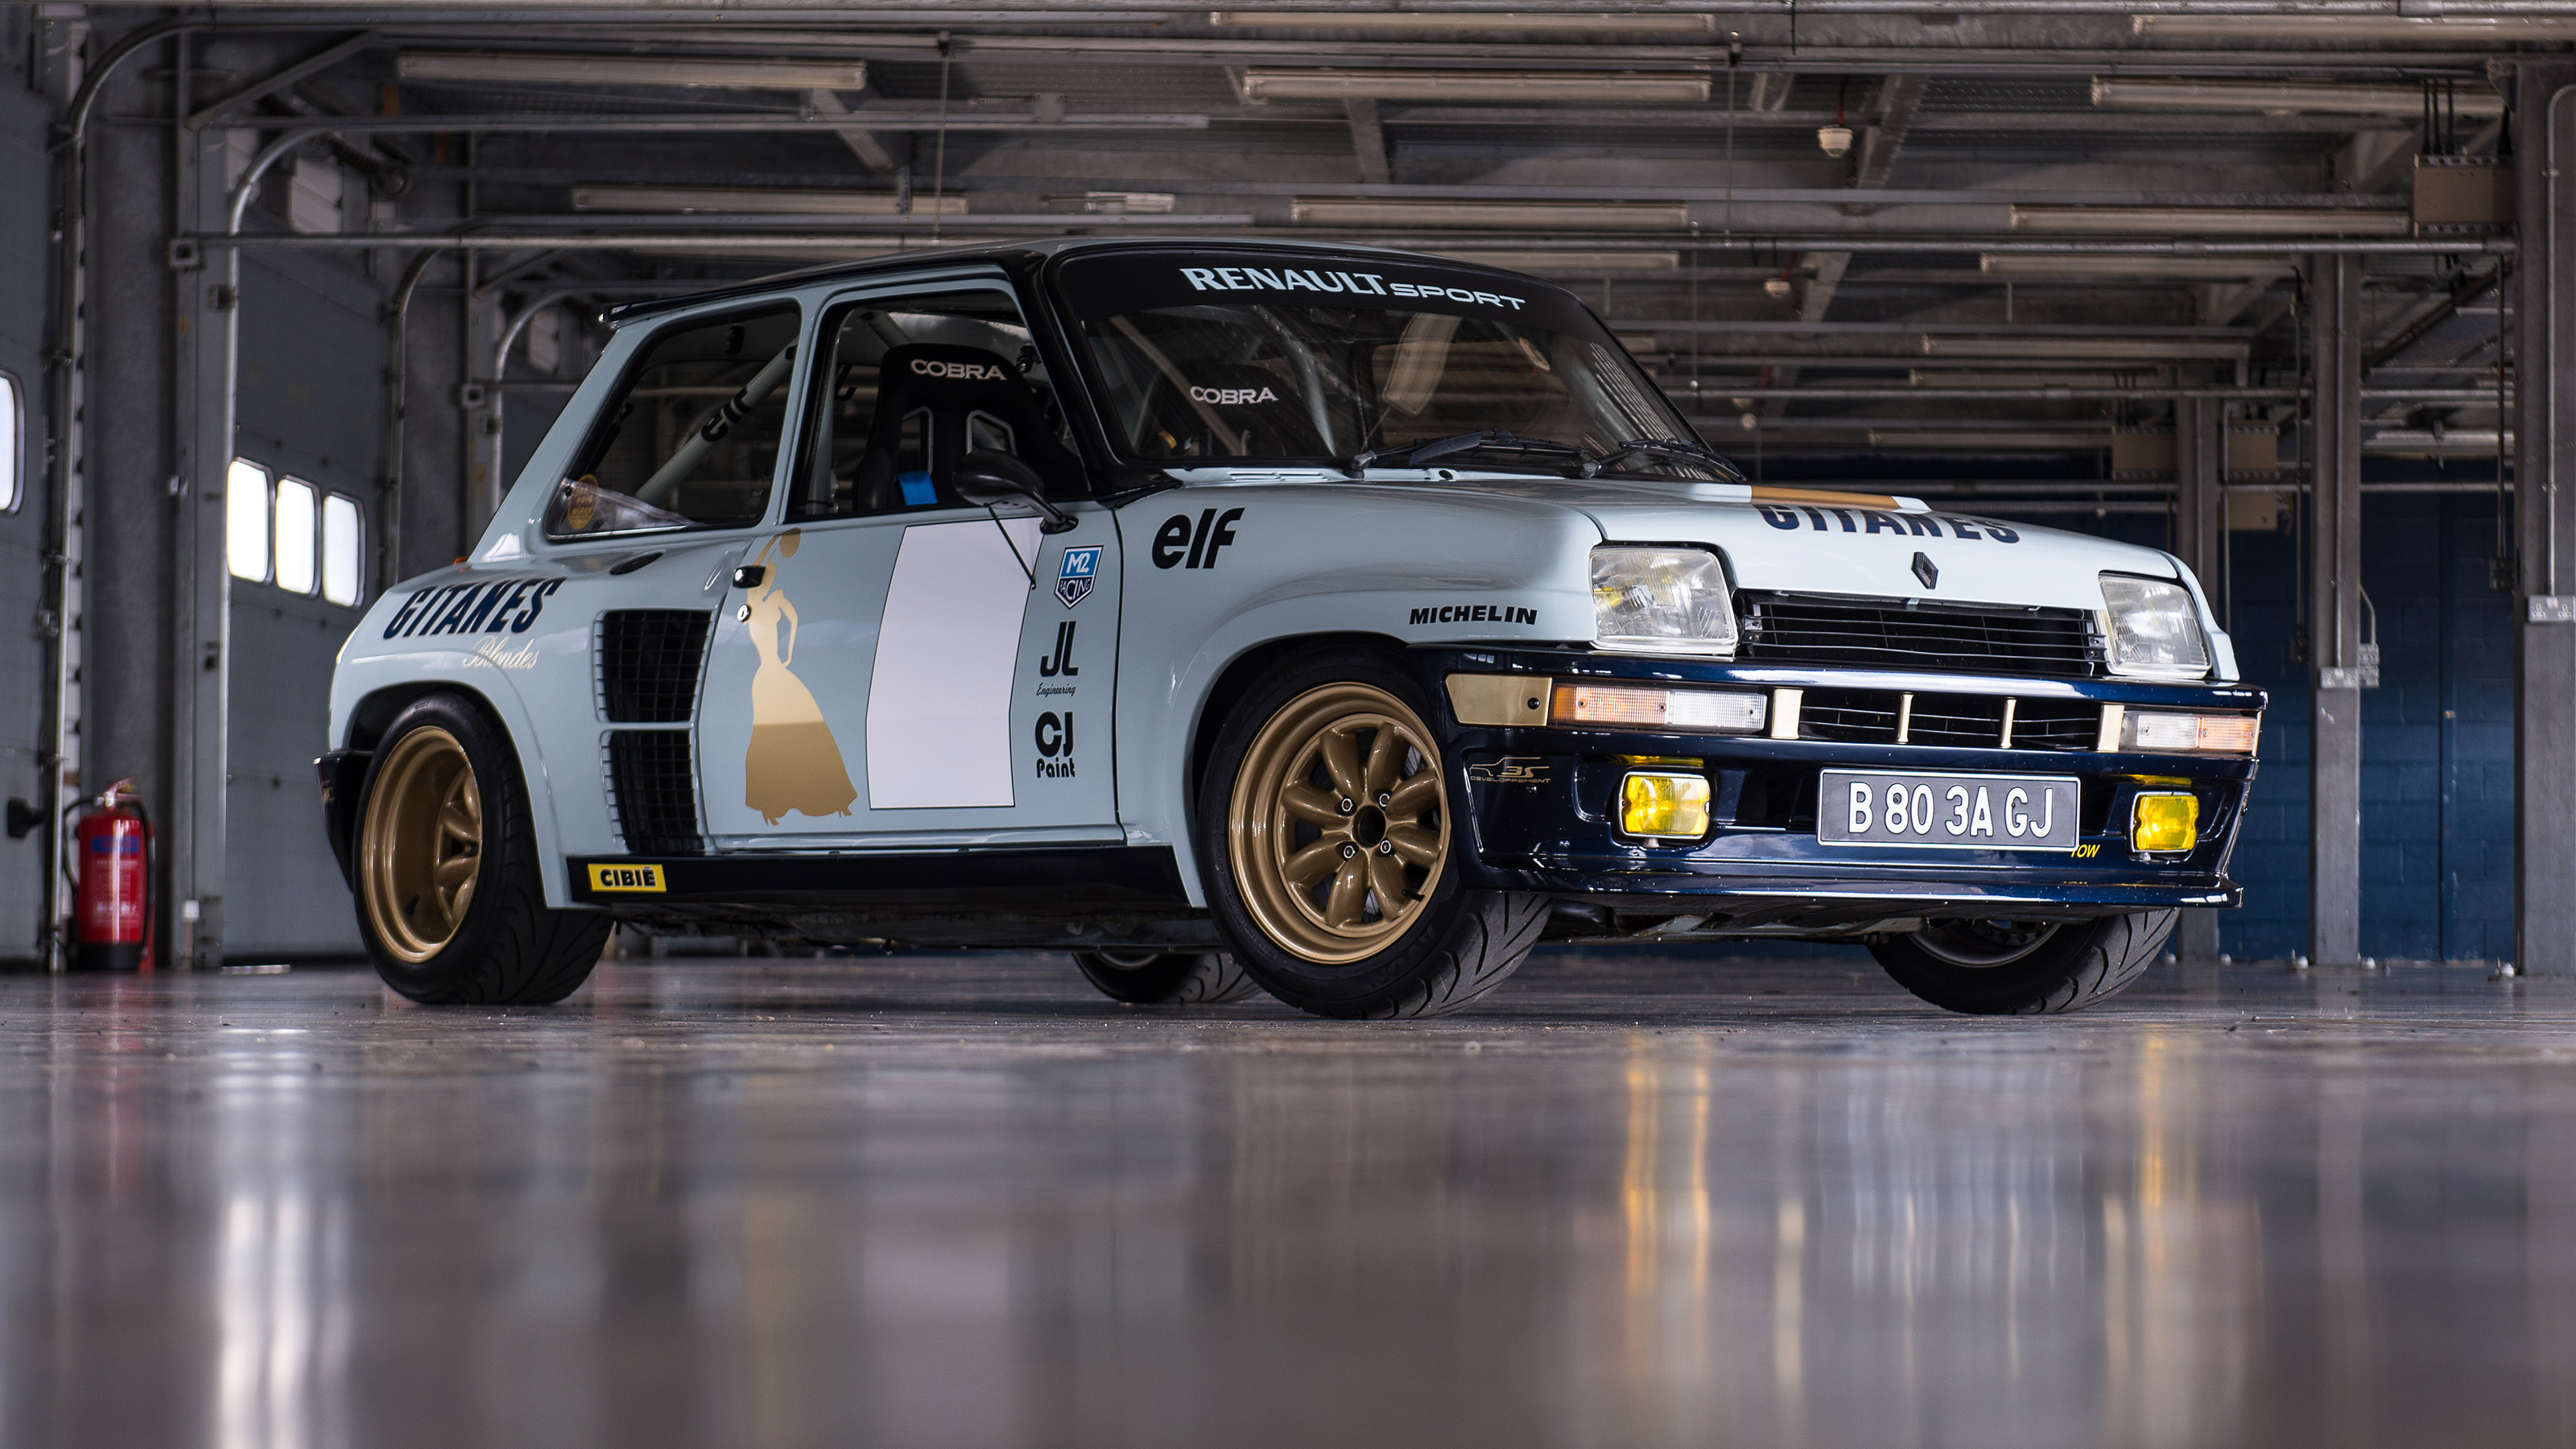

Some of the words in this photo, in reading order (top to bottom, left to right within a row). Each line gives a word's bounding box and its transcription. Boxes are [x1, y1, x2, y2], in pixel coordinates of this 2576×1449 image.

[1179, 266, 1387, 295] RENAULT
[1389, 282, 1525, 310] SPORT
[910, 358, 1007, 382] COBRA
[1189, 385, 1279, 406] COBRA
[1151, 507, 1245, 569] elf
[1753, 503, 2021, 544] GITANES
[1067, 552, 1091, 574] M2
[1060, 578, 1091, 601] RACING
[382, 576, 568, 640] GITANES
[1409, 605, 1538, 626] MICHELIN
[462, 635, 540, 671] Blondes
[1040, 621, 1080, 677] JL
[1036, 683, 1076, 698] Engineering
[1034, 710, 1074, 758] CJ
[1036, 757, 1075, 778] Paint
[1470, 775, 1551, 783] DEVELOPPEMENT
[1848, 781, 1874, 834] B
[1885, 782, 1934, 836] 80
[1945, 784, 1994, 837] 3A
[2004, 786, 2054, 839] GJ
